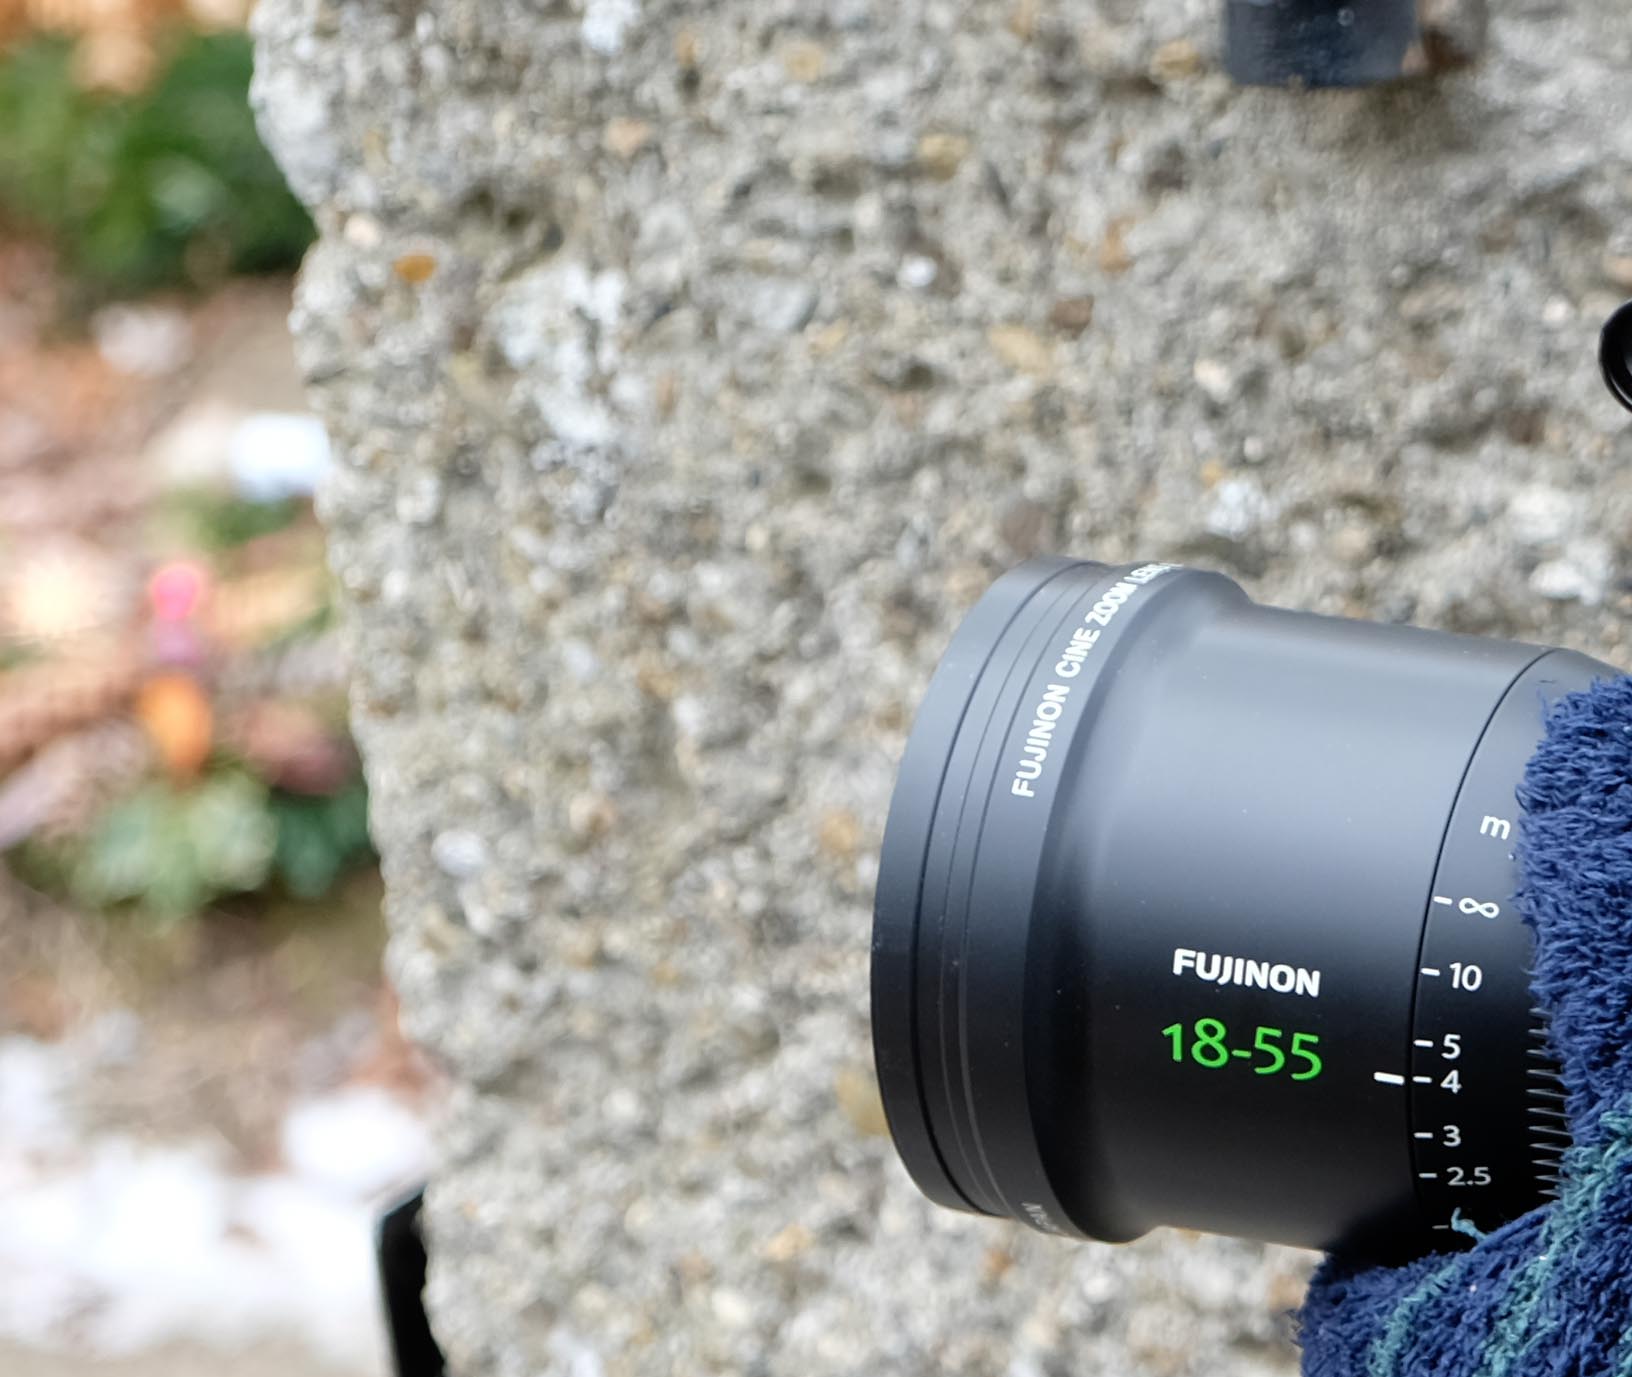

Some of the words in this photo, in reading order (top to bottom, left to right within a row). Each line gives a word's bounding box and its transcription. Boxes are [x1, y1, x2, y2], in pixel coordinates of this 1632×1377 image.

[1011, 683, 1071, 798] FUJINON
[1054, 627, 1101, 679] CINE
[1084, 581, 1138, 627] ZOOM
[1479, 815, 1511, 840] m
[1172, 948, 1321, 998] FUJINON
[1449, 962, 1483, 992] 10
[1161, 1017, 1322, 1080] 18-55
[1441, 1033, 1461, 1060] 5
[1440, 1069, 1462, 1094] 4
[1443, 1124, 1462, 1147] 3
[1446, 1166, 1492, 1186] 2.5
